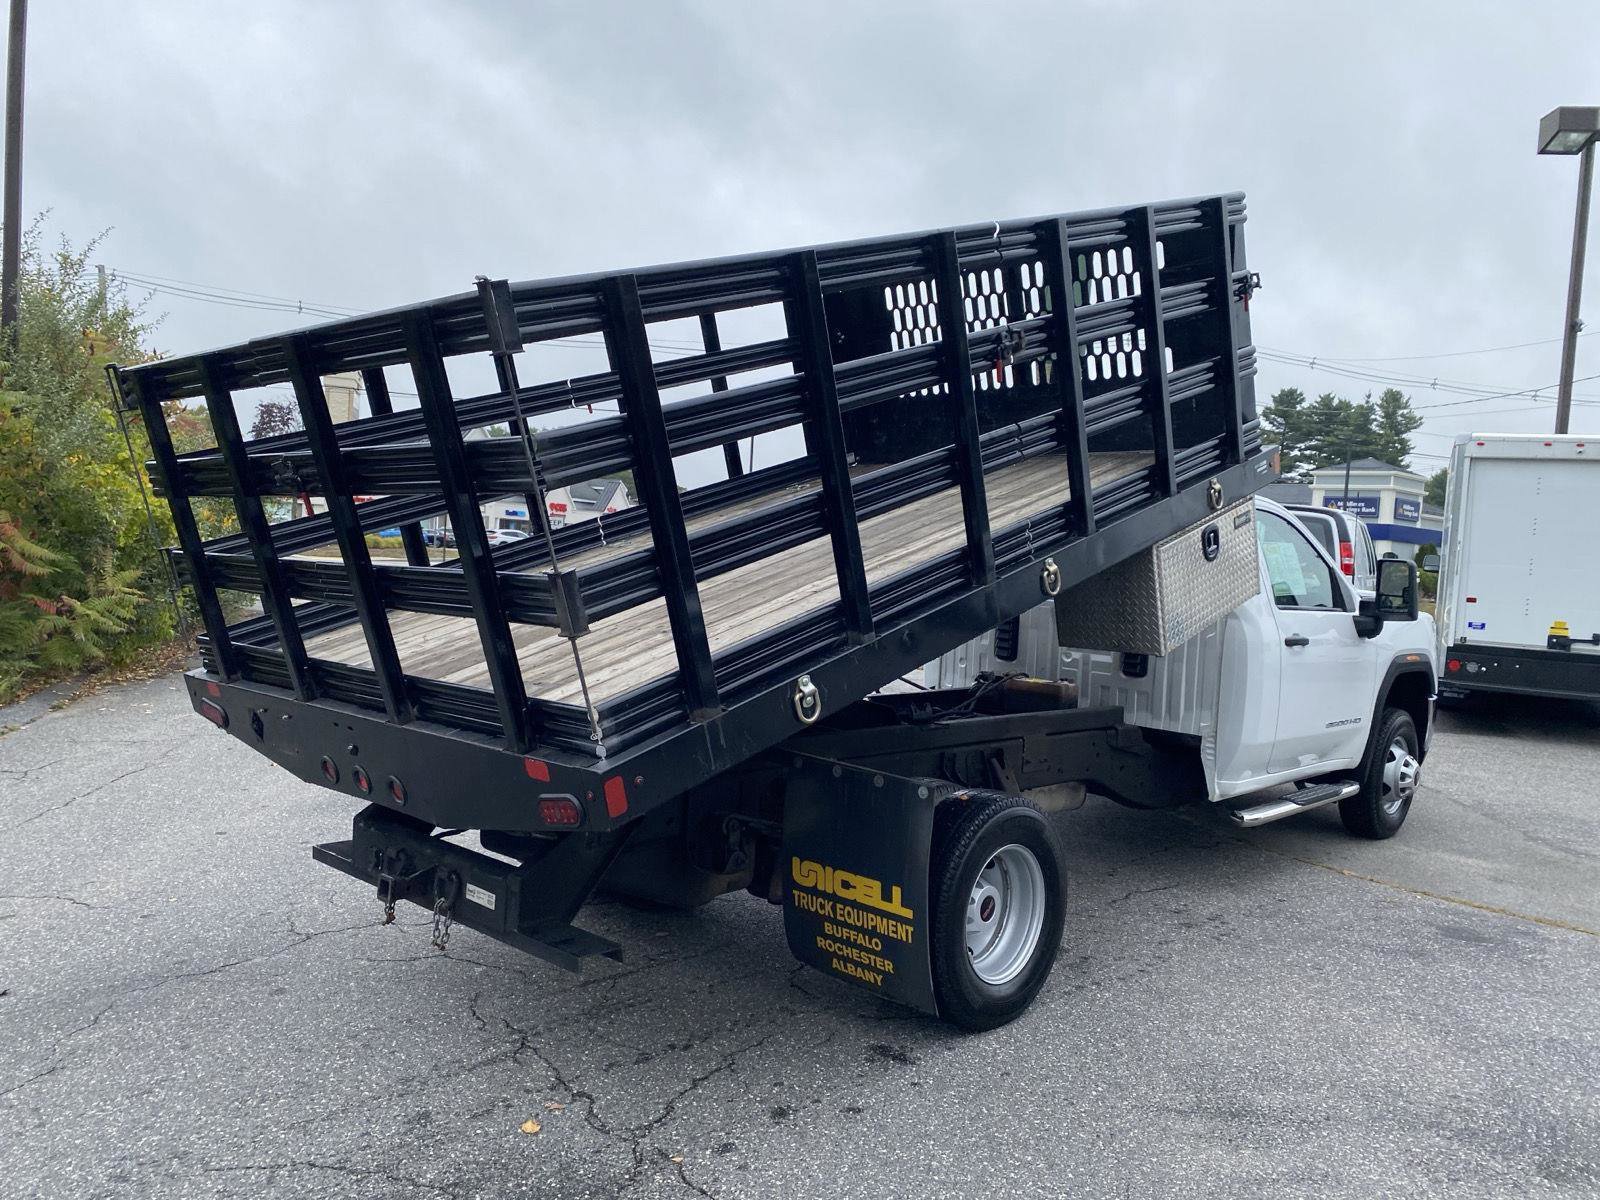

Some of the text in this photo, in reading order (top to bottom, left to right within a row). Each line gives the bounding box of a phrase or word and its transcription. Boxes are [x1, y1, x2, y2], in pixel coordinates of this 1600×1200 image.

[792, 889, 914, 943] TRUCK EQUIPMENT
[824, 921, 882, 951] BUFFALO
[816, 936, 895, 974] ROCHESTER
[832, 958, 884, 987] ALBANY
